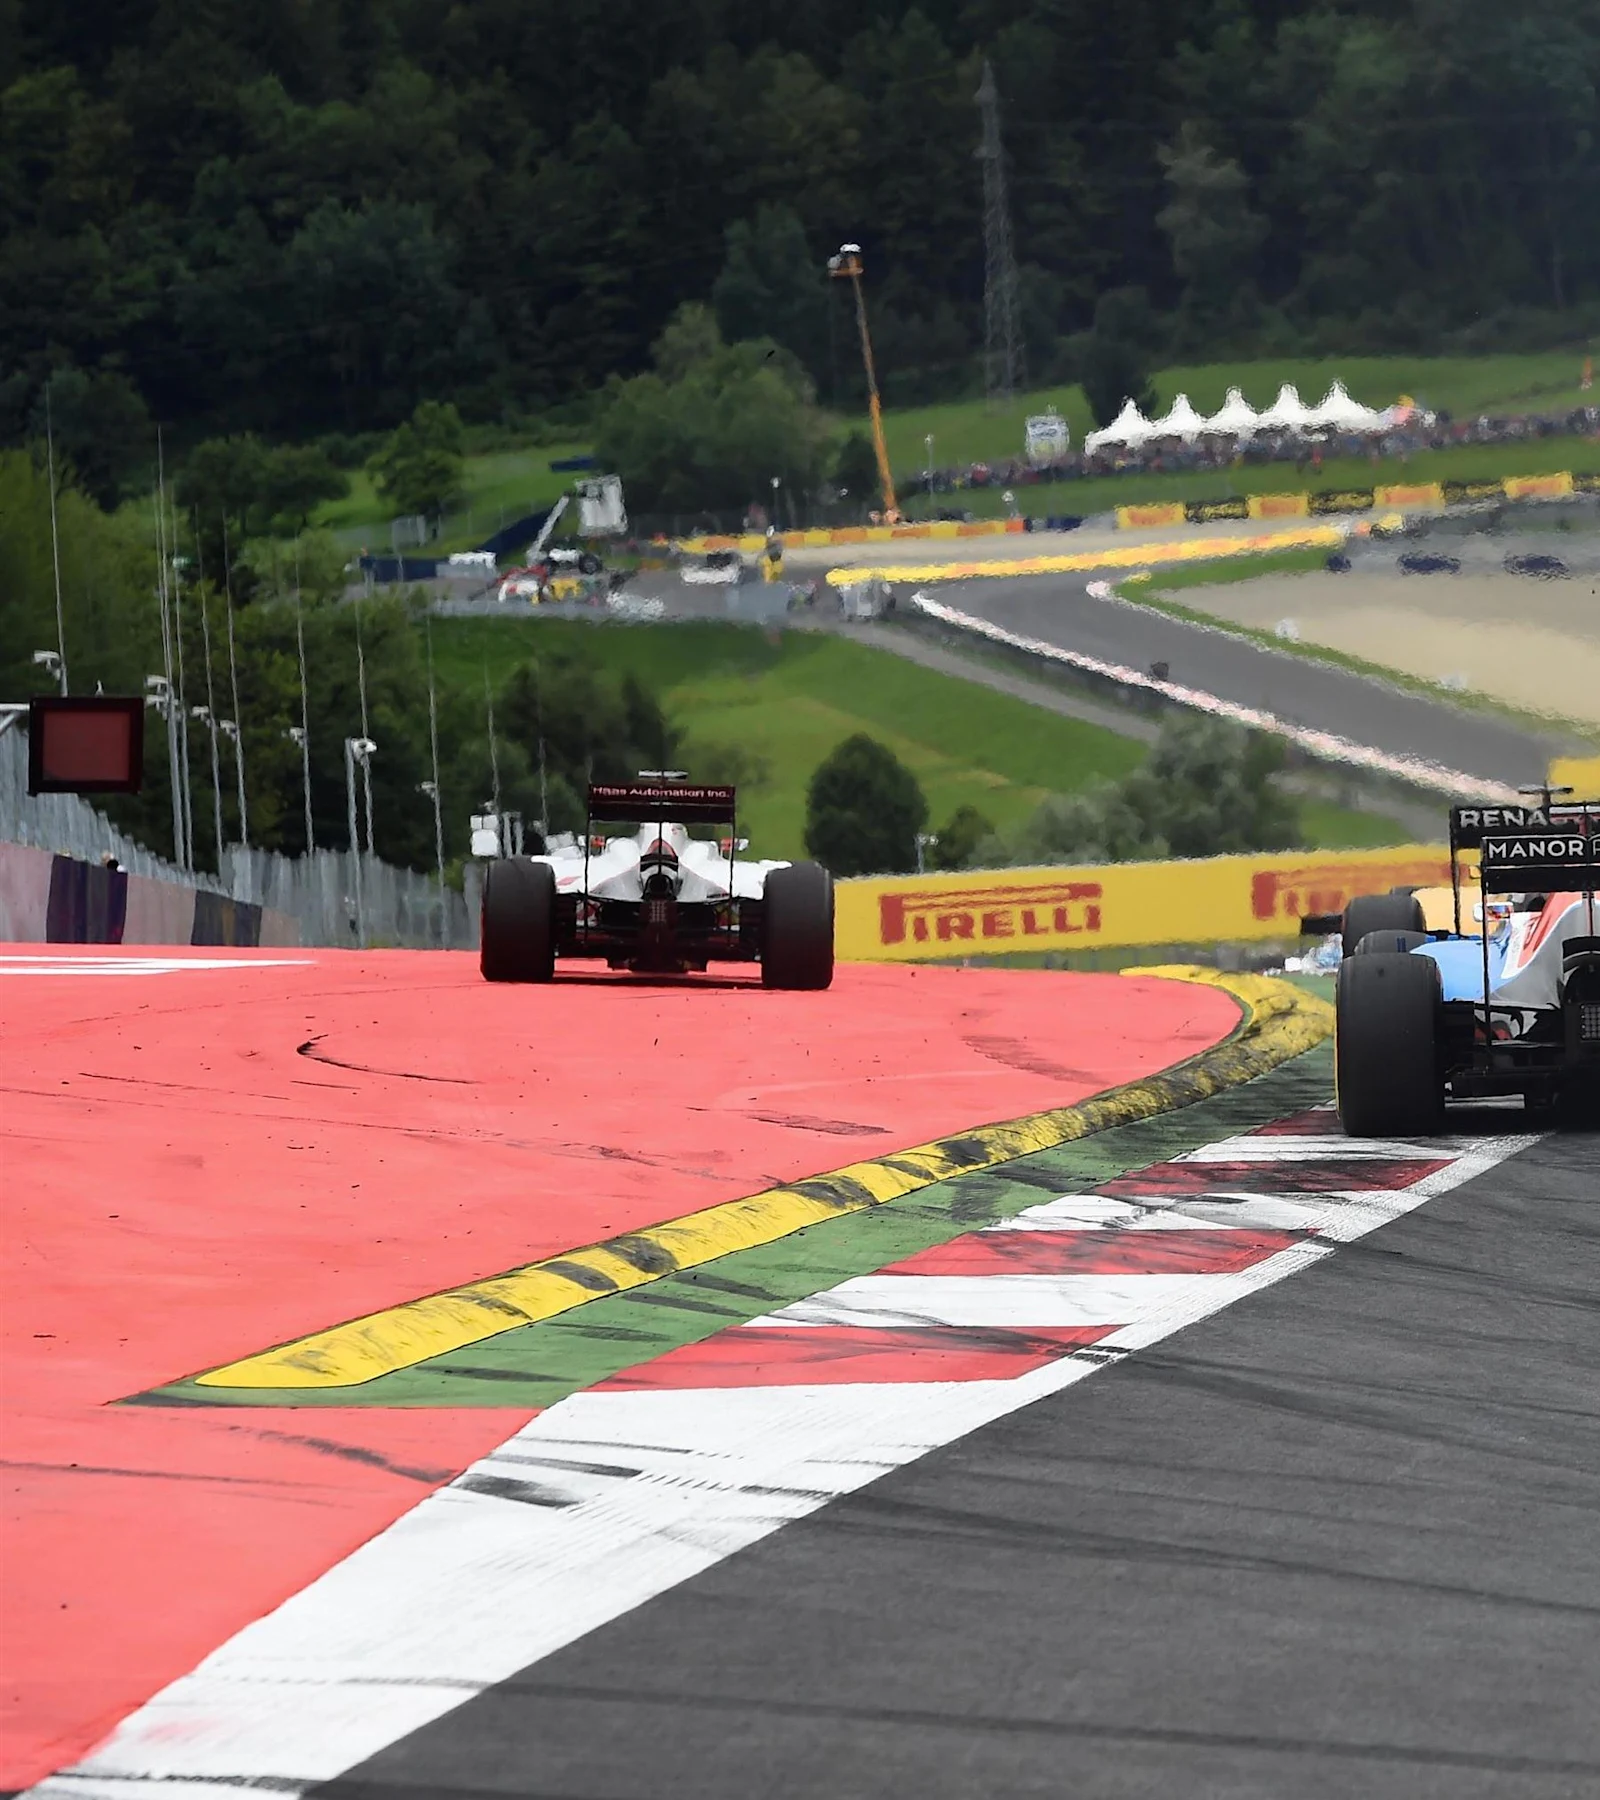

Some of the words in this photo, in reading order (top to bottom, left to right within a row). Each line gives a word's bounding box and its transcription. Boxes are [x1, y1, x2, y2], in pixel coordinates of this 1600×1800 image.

[593, 787, 627, 796] Haas
[630, 787, 705, 798] Automation
[707, 789, 730, 798] Inc.
[1459, 809, 1548, 828] RENA
[1488, 840, 1584, 859] MANOR
[879, 882, 1103, 944] PIRELLI
